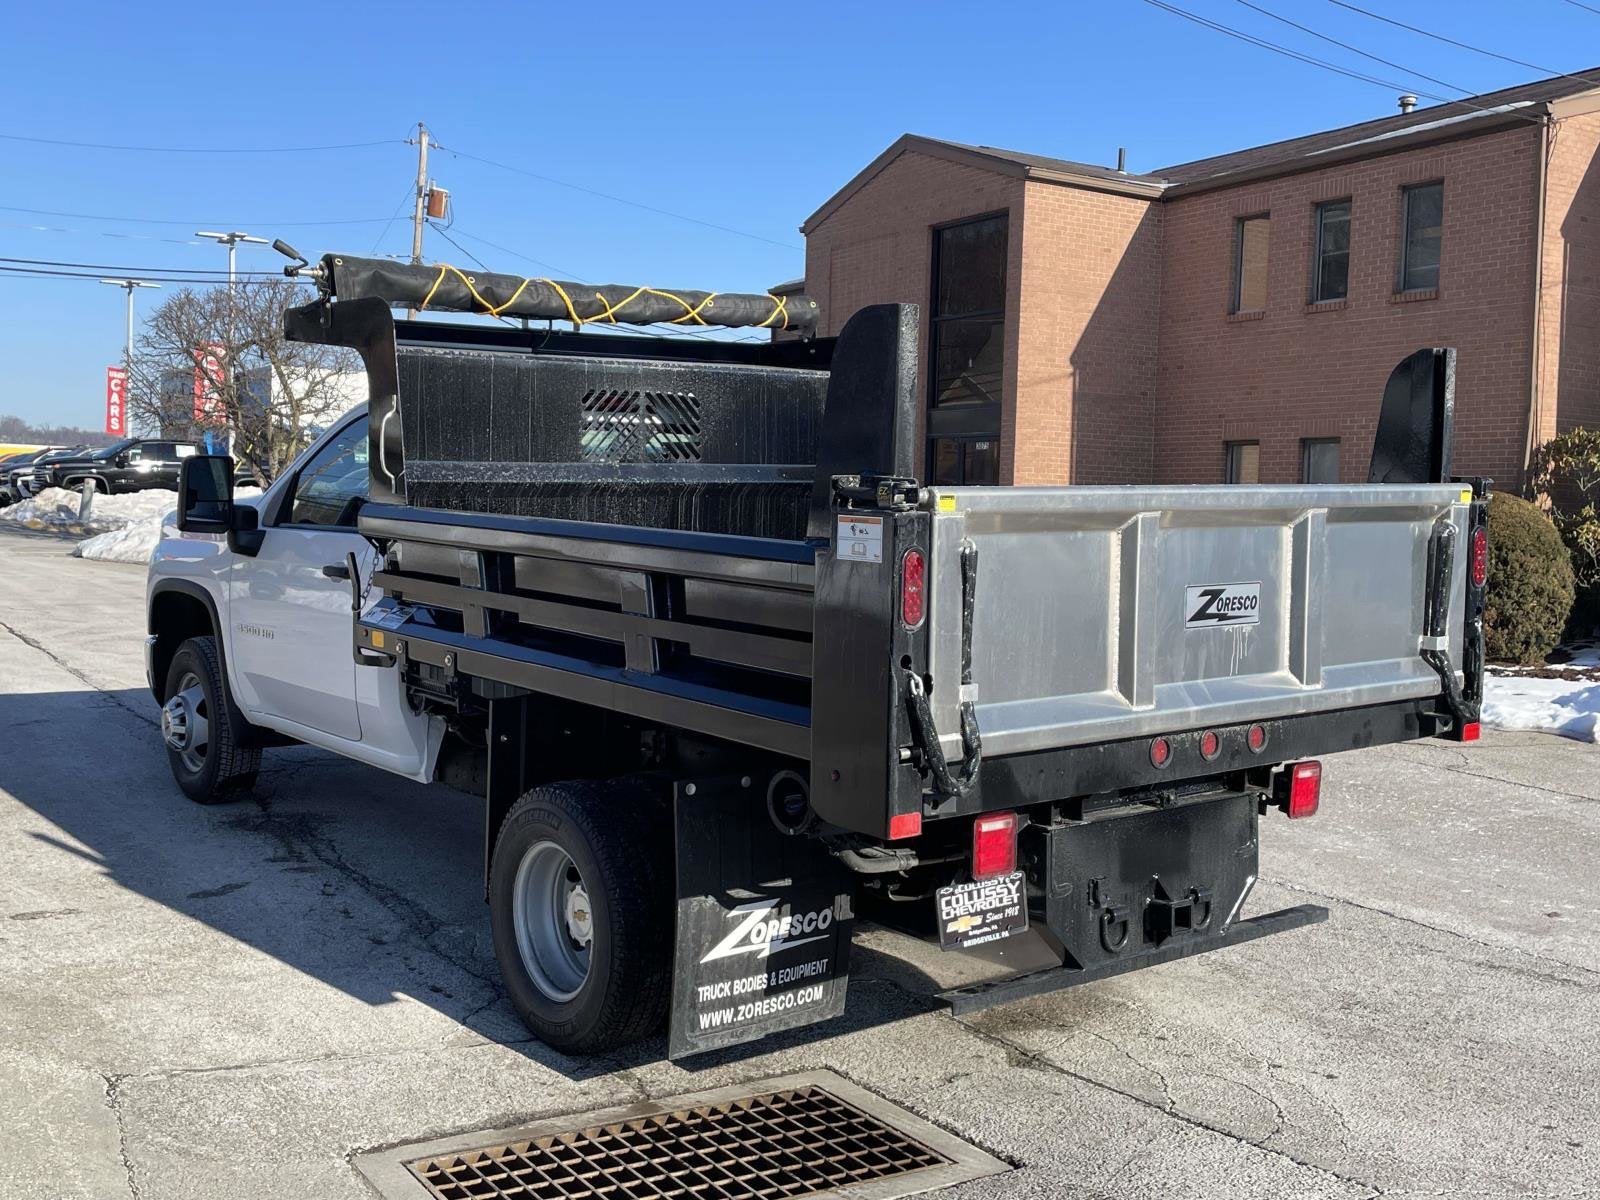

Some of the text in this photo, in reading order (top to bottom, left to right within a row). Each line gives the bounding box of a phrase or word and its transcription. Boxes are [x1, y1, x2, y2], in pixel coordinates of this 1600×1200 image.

[110, 379, 122, 430] CARS
[1187, 588, 1258, 622] ZORESCO
[941, 880, 1020, 911] COLUSSY
[942, 893, 1020, 920] CHEVROLET
[700, 898, 832, 963] ZORESCO
[986, 906, 1020, 923] Since 1918
[1001, 930, 1009, 938] PA
[698, 959, 828, 1002] TRUCK BODIES & EQUIPMENT
[700, 985, 823, 1029] WWW.ZORESCO.COM
